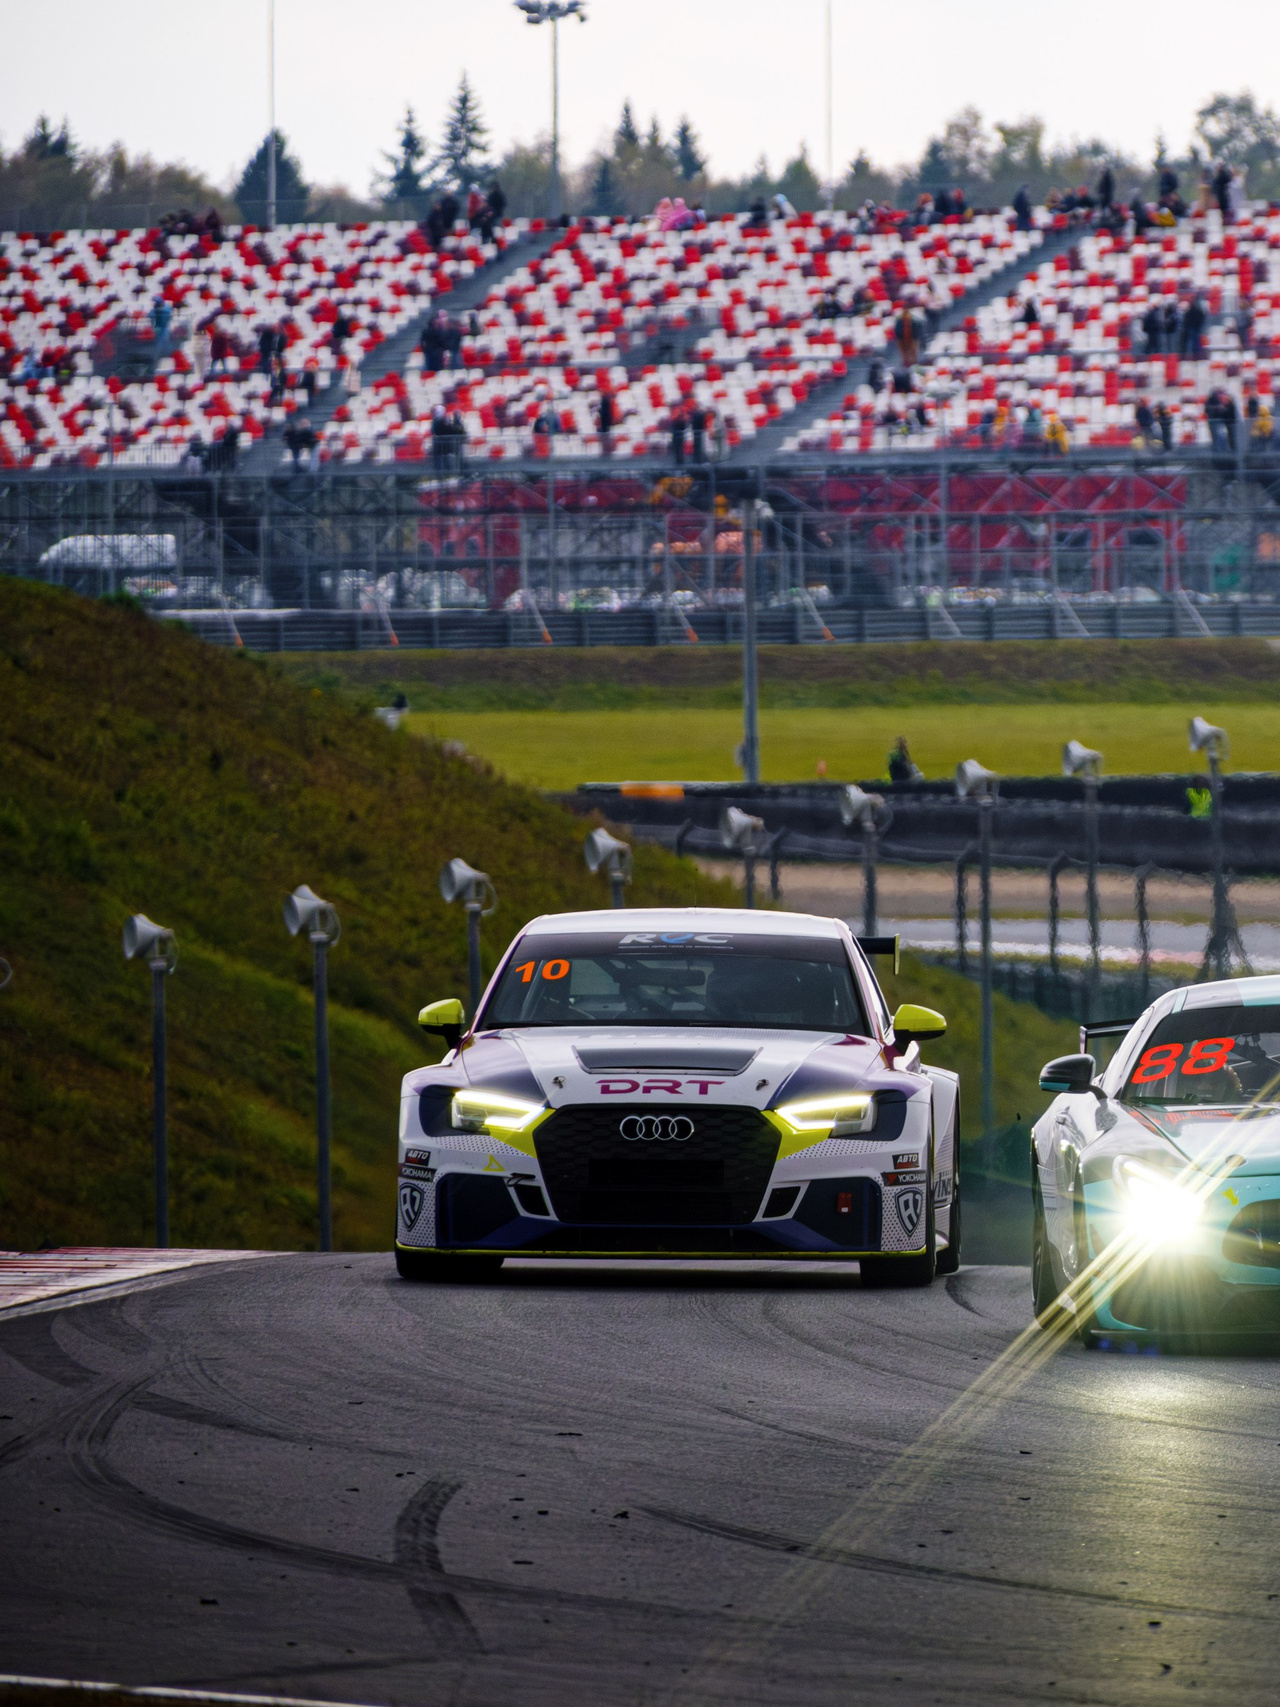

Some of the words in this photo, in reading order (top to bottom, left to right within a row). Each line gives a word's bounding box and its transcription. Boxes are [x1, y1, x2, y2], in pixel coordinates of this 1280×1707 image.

[514, 958, 571, 983] 10
[1131, 1037, 1236, 1085] 88
[595, 1078, 726, 1096] DRT
[898, 1172, 926, 1183] YOKOHAM
